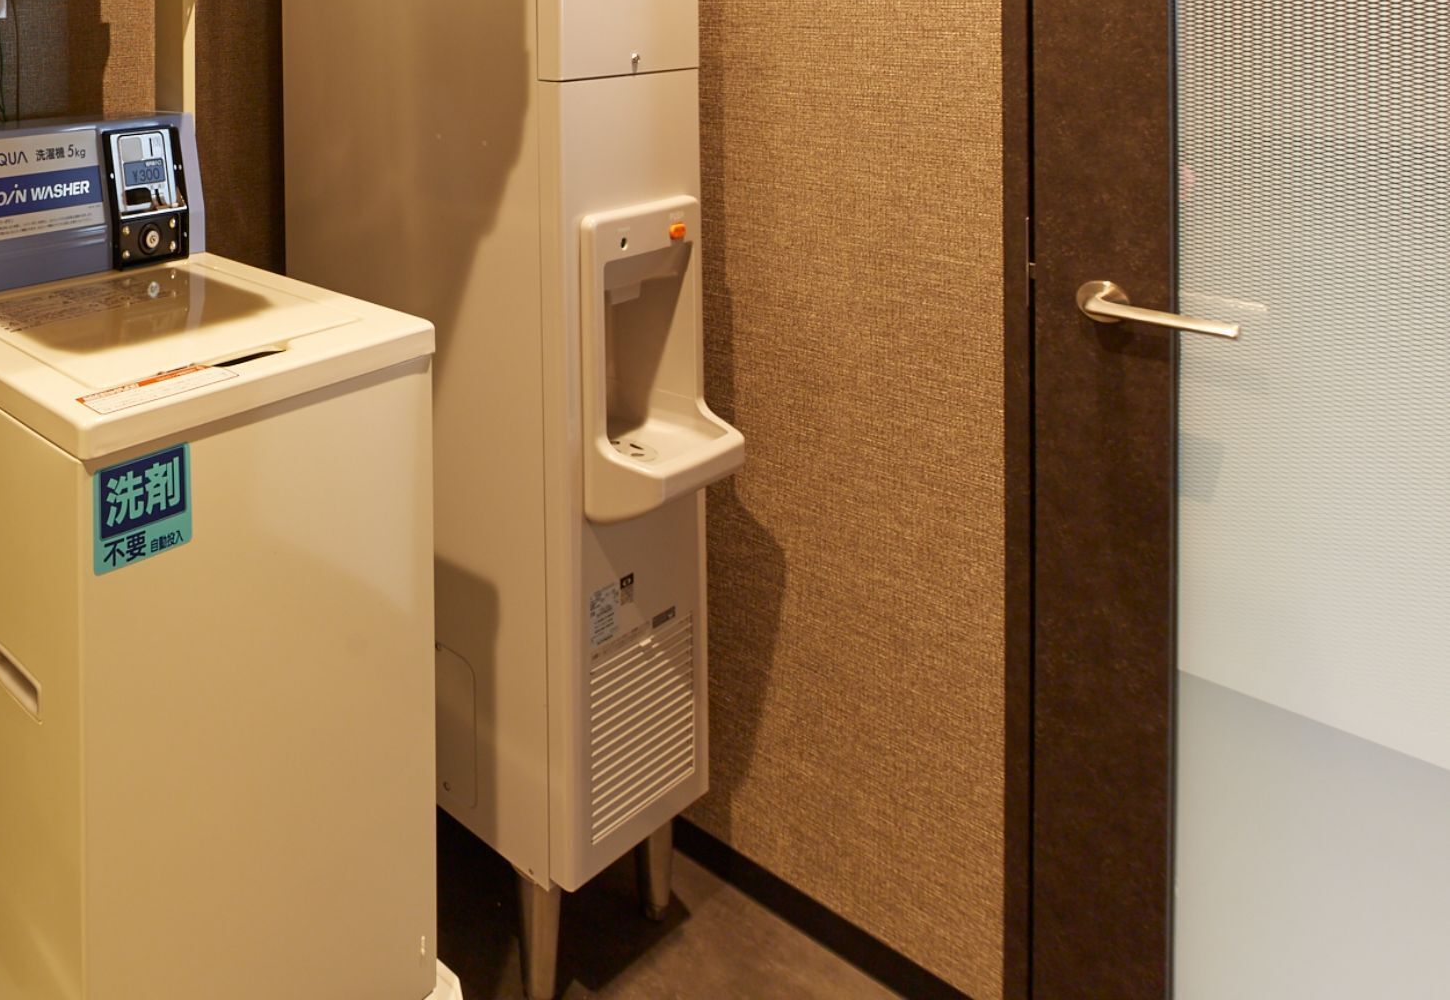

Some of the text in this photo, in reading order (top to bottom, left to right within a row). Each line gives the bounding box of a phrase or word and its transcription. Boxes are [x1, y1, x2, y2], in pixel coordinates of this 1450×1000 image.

[35, 147, 65, 162] 洗濯機
[67, 143, 86, 159] 5kg
[132, 167, 160, 183] ¥300
[30, 179, 90, 202] WASHER
[106, 456, 181, 528] 洗剤
[103, 530, 184, 567] 不要 自動投入
